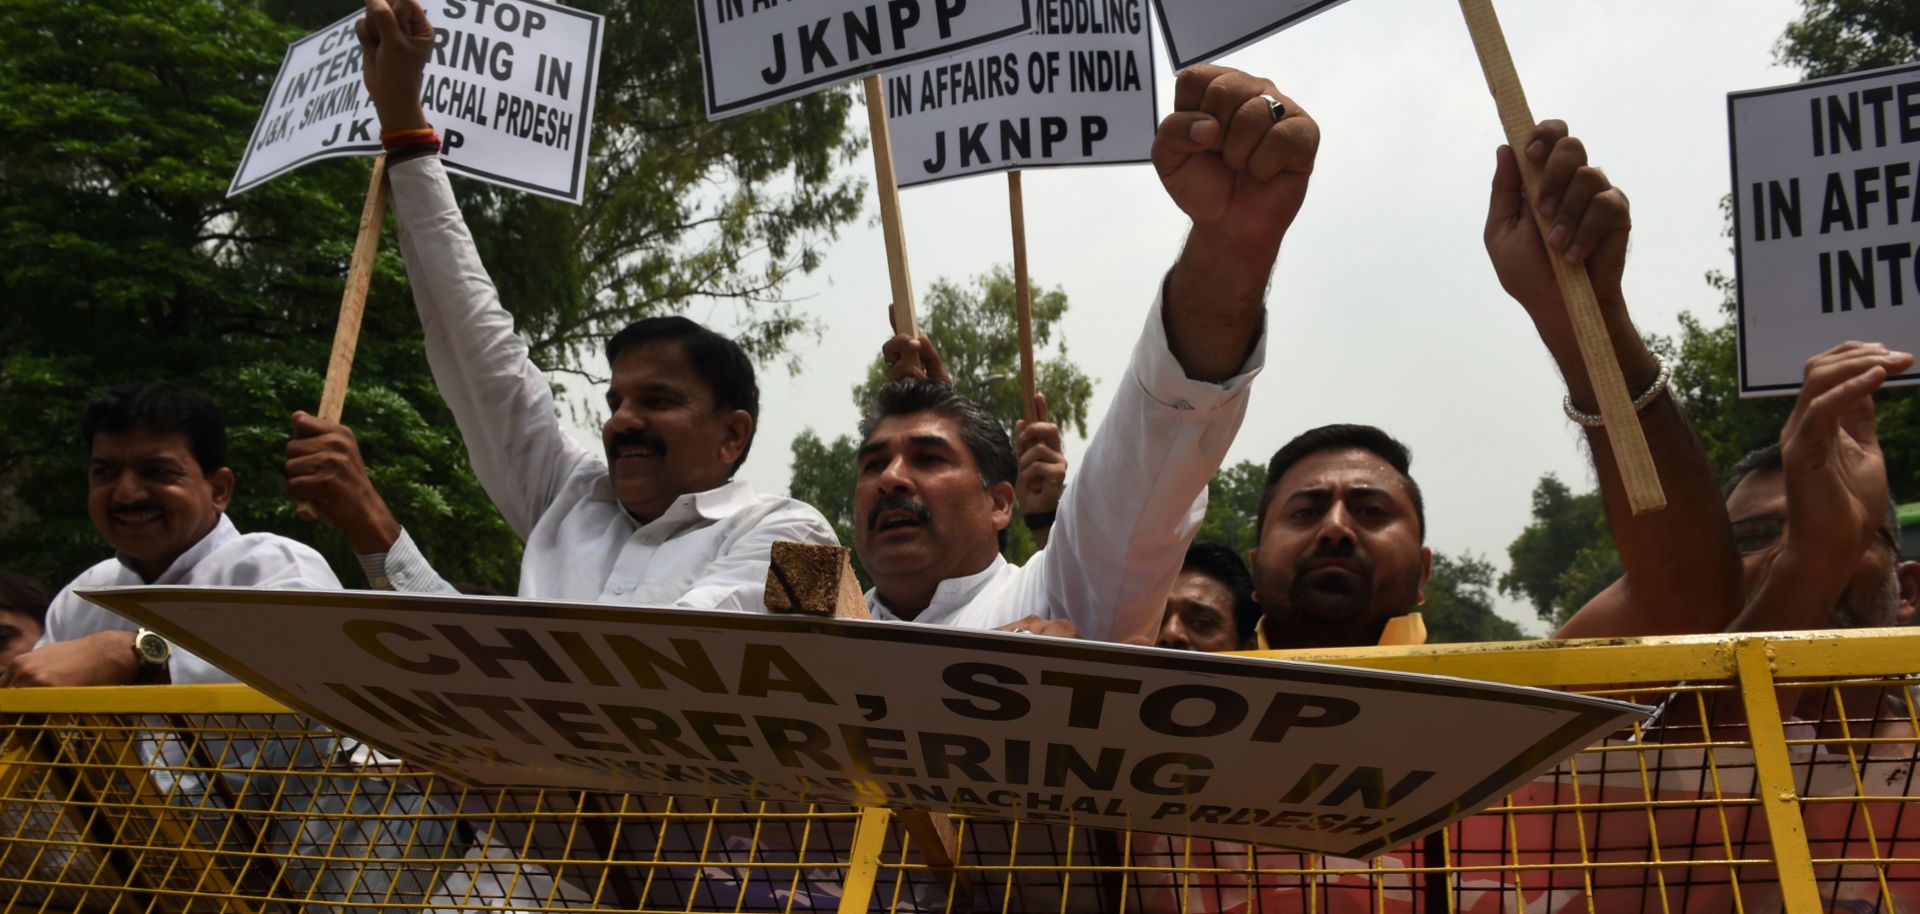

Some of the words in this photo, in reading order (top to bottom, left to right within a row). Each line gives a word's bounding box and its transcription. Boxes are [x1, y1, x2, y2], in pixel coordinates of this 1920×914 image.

[442, 0, 546, 38] STOP
[761, 0, 967, 85] JKNPP
[535, 53, 573, 100] IN
[889, 75, 912, 118] IN
[920, 52, 1019, 112] AFFAIRS
[1027, 51, 1060, 94] OF
[1070, 49, 1142, 93] INDIA
[493, 91, 573, 151] PRDESH
[923, 115, 1109, 174] JKNPP
[1752, 177, 1802, 242] IN
[1820, 160, 1920, 234] AFF
[1819, 241, 1920, 314] INT
[940, 662, 1361, 744] STOP
[322, 682, 1215, 796] INTERFRERING
[1279, 763, 1436, 810] IN
[1151, 802, 1395, 835] PRDESH
